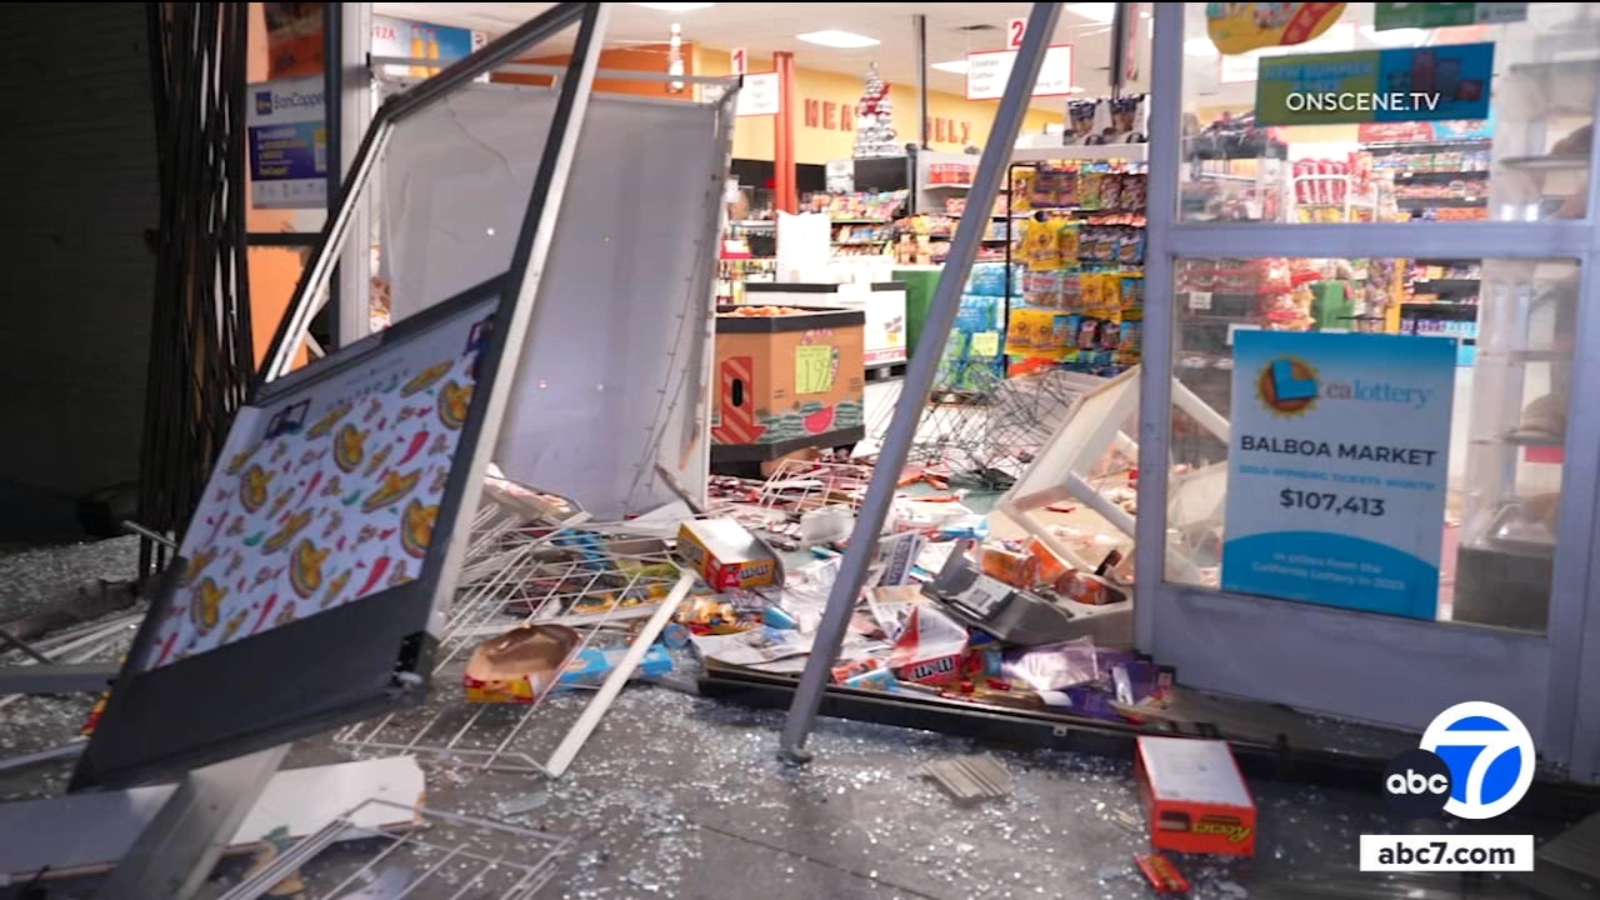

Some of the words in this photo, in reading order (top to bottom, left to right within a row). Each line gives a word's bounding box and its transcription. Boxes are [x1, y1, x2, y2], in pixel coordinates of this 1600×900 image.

[1011, 20, 1024, 46] 2
[733, 49, 744, 73] 1
[1241, 435, 1332, 458] BALBOA
[1338, 443, 1438, 467] MARKET
[1279, 487, 1385, 516] $107,413
